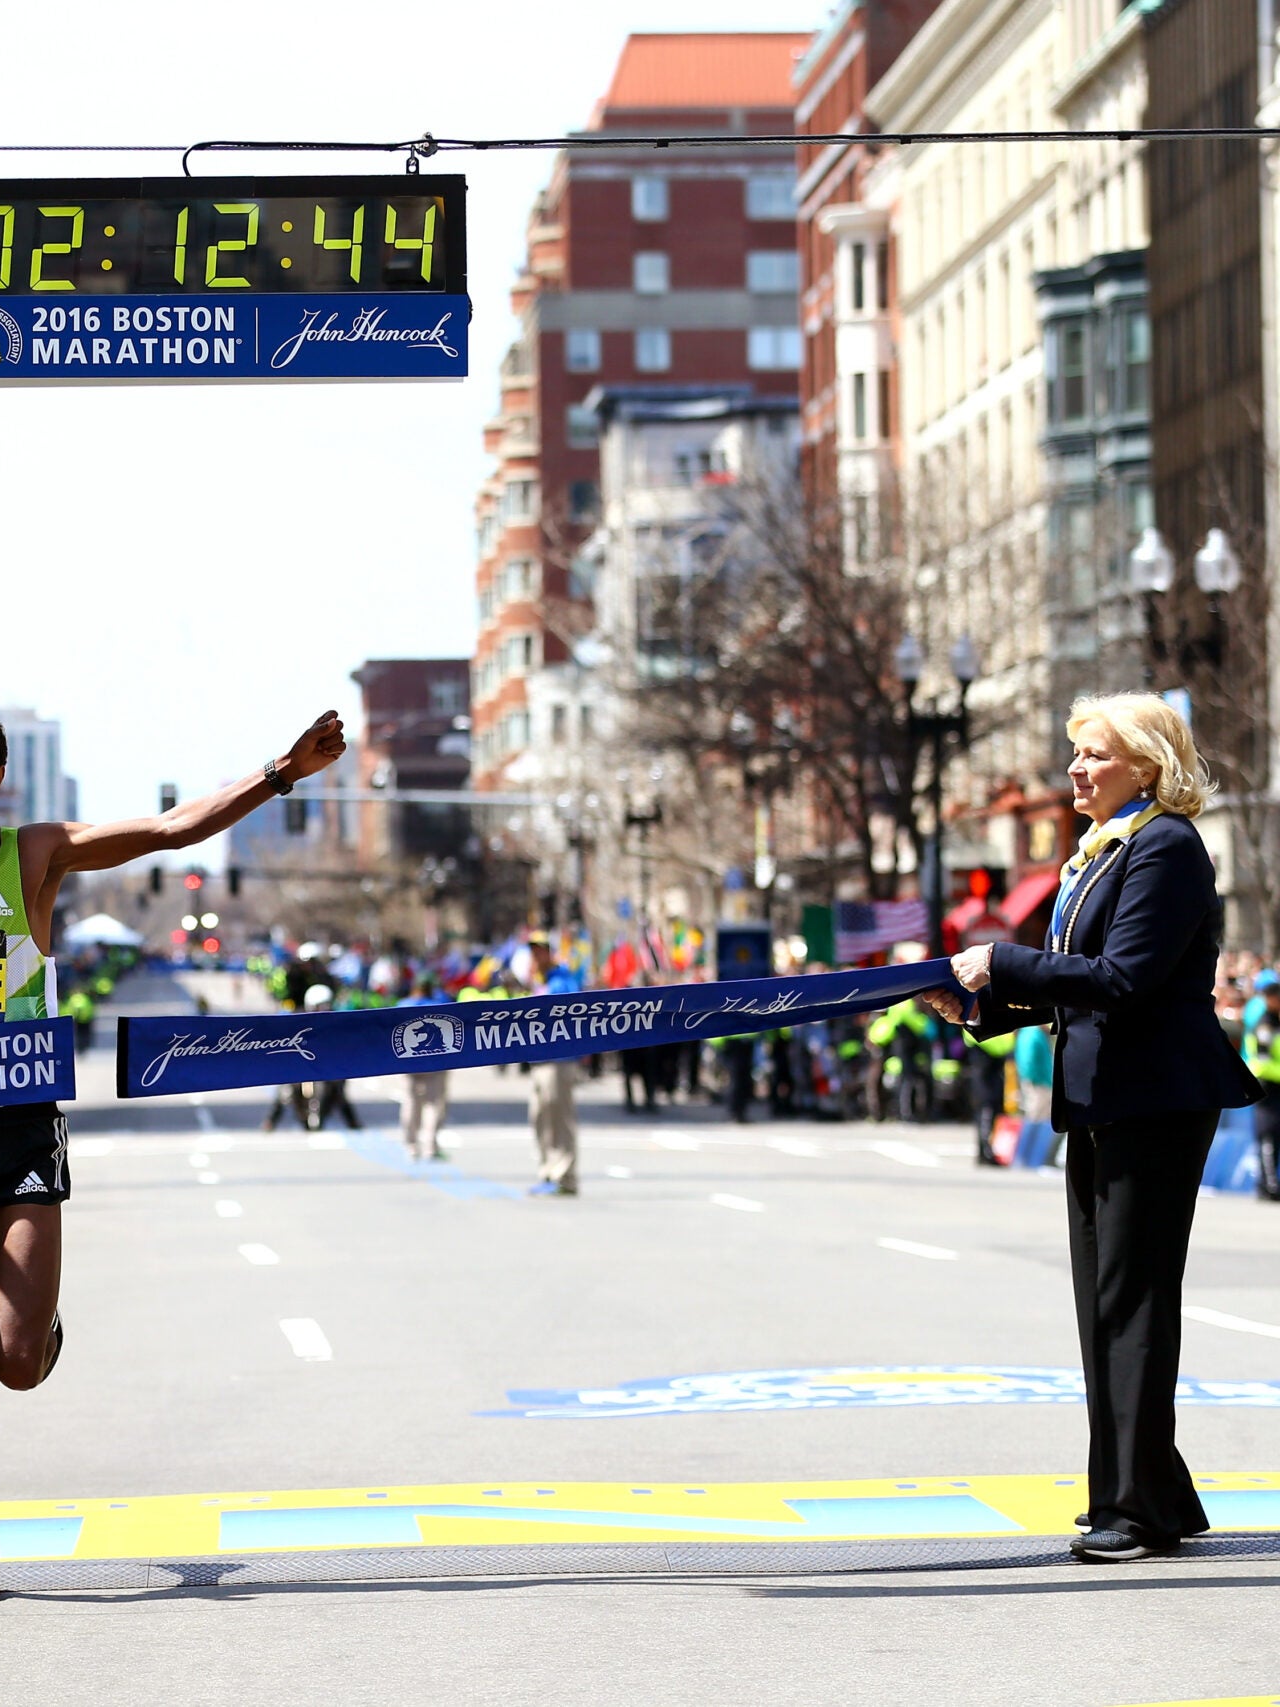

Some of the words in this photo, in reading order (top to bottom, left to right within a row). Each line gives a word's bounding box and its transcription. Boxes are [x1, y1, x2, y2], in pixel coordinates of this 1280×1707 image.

[32, 307, 101, 332] 2016
[113, 307, 235, 332] BOSTON
[32, 337, 236, 365] MARATHON
[476, 1008, 541, 1022] 2016
[549, 999, 664, 1018] BOSTON
[394, 1024, 405, 1053] BOSTON
[474, 1012, 656, 1051] MARATHON
[14, 1183, 49, 1195] adidas
